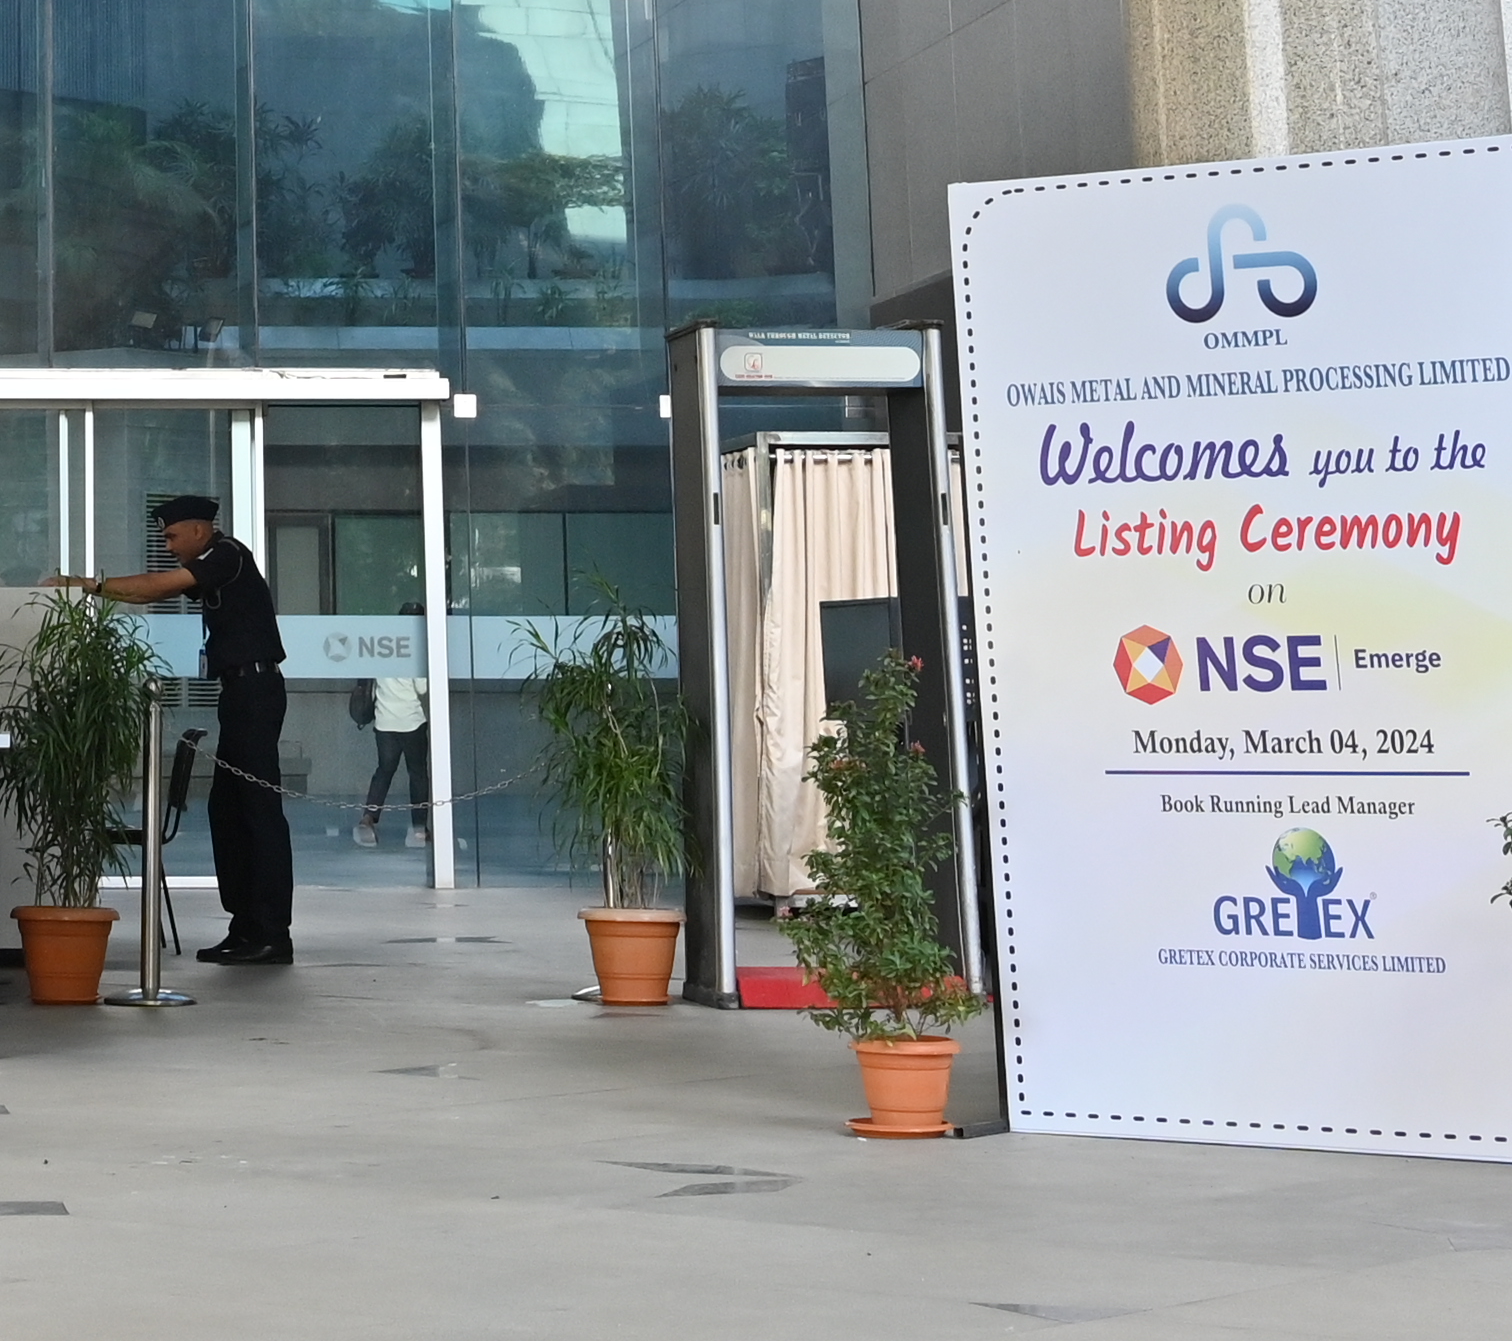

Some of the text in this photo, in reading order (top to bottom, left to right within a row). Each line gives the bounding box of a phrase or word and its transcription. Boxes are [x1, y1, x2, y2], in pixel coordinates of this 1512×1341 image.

[1203, 329, 1288, 350] OMMPL
[1007, 357, 1511, 408] OWAIS METAL AND MINERAL PROCESSING LIMITED
[1038, 420, 1486, 489] Welcomes you to the
[1073, 503, 1461, 573] Listing Ceremony
[1247, 581, 1287, 607] on
[357, 635, 412, 658] NSE
[1195, 633, 1442, 692] NSE Emerge
[1132, 728, 1435, 760] Monday, March 04, 2024
[1160, 793, 1415, 820] Book Running Lead Manager
[1213, 894, 1375, 940] GRETEX
[1158, 948, 1446, 975] GRETEX CORPORATE SERVICES LIMITED
